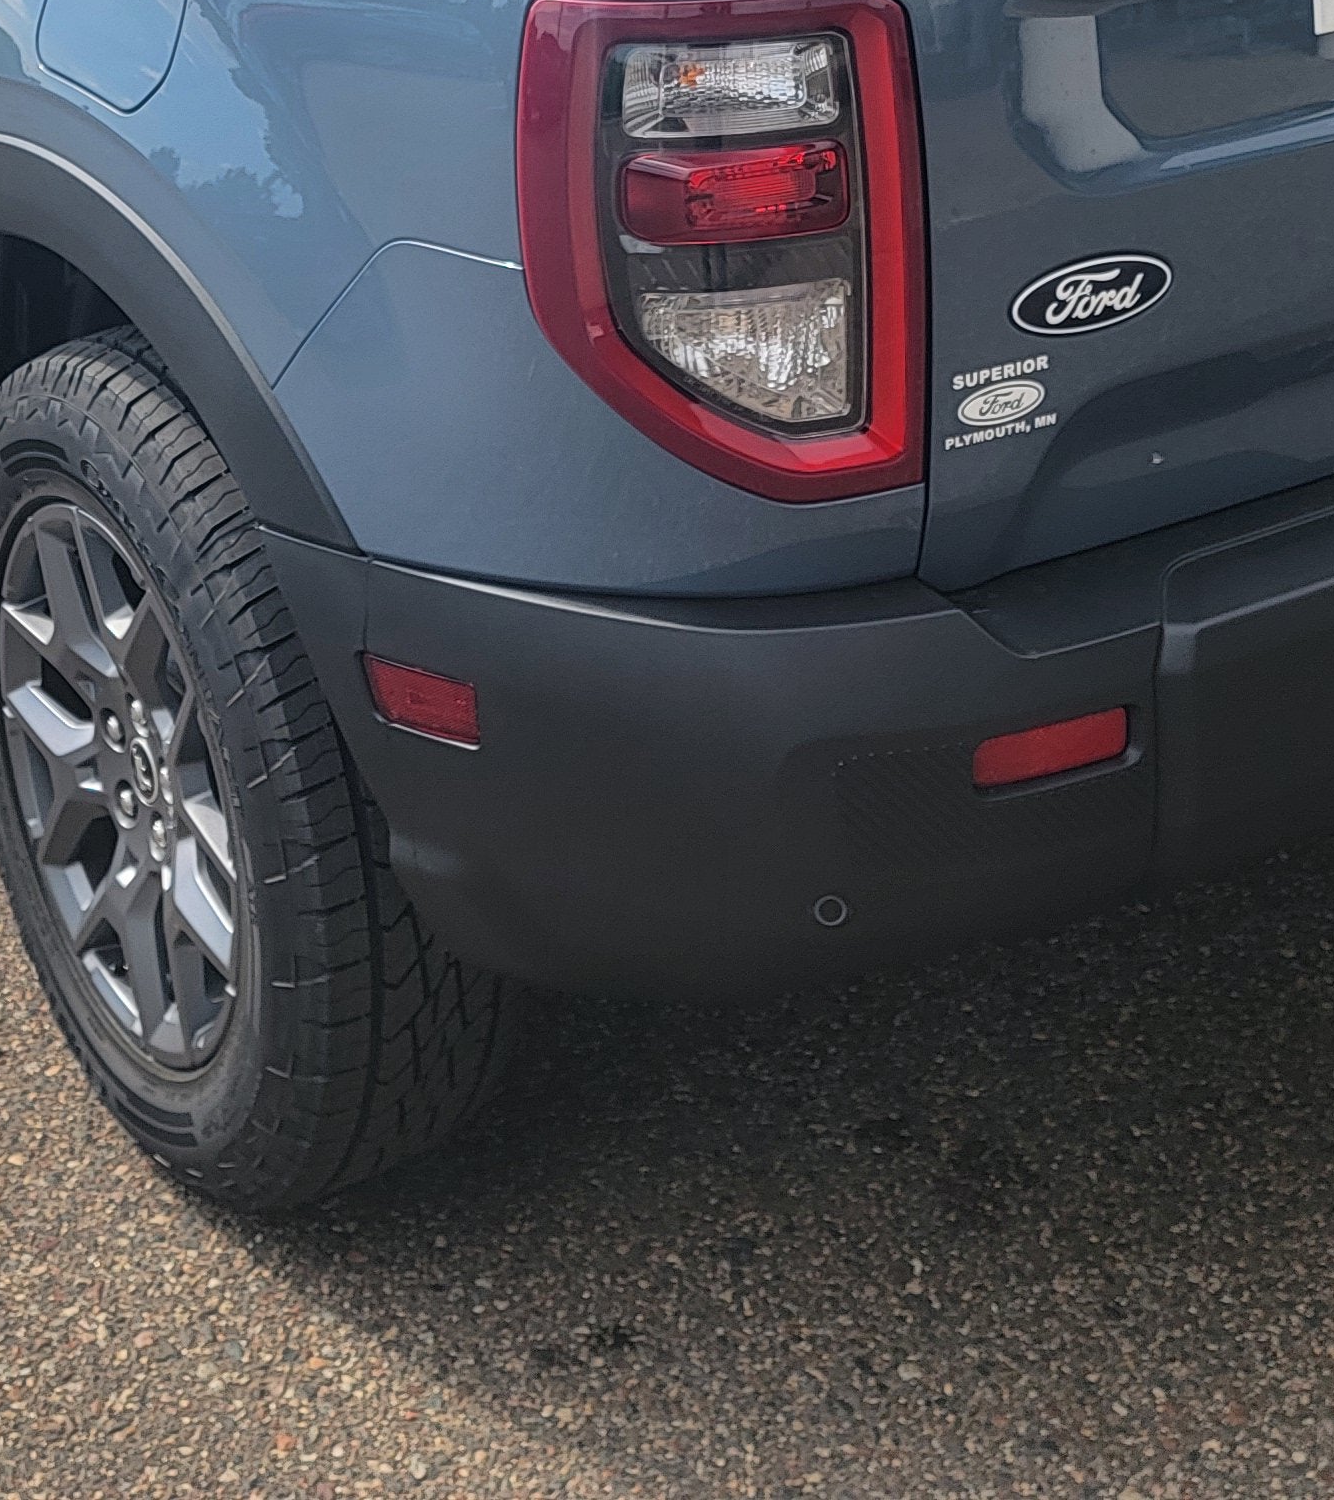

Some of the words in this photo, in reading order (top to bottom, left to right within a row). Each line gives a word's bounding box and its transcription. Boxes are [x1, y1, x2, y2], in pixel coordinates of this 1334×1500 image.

[1045, 268, 1144, 325] Ford
[952, 355, 1049, 391] SUPERIOR
[979, 391, 1025, 416] Ford
[945, 422, 1032, 451] PLYMOUTH,
[1034, 413, 1057, 429] MN
